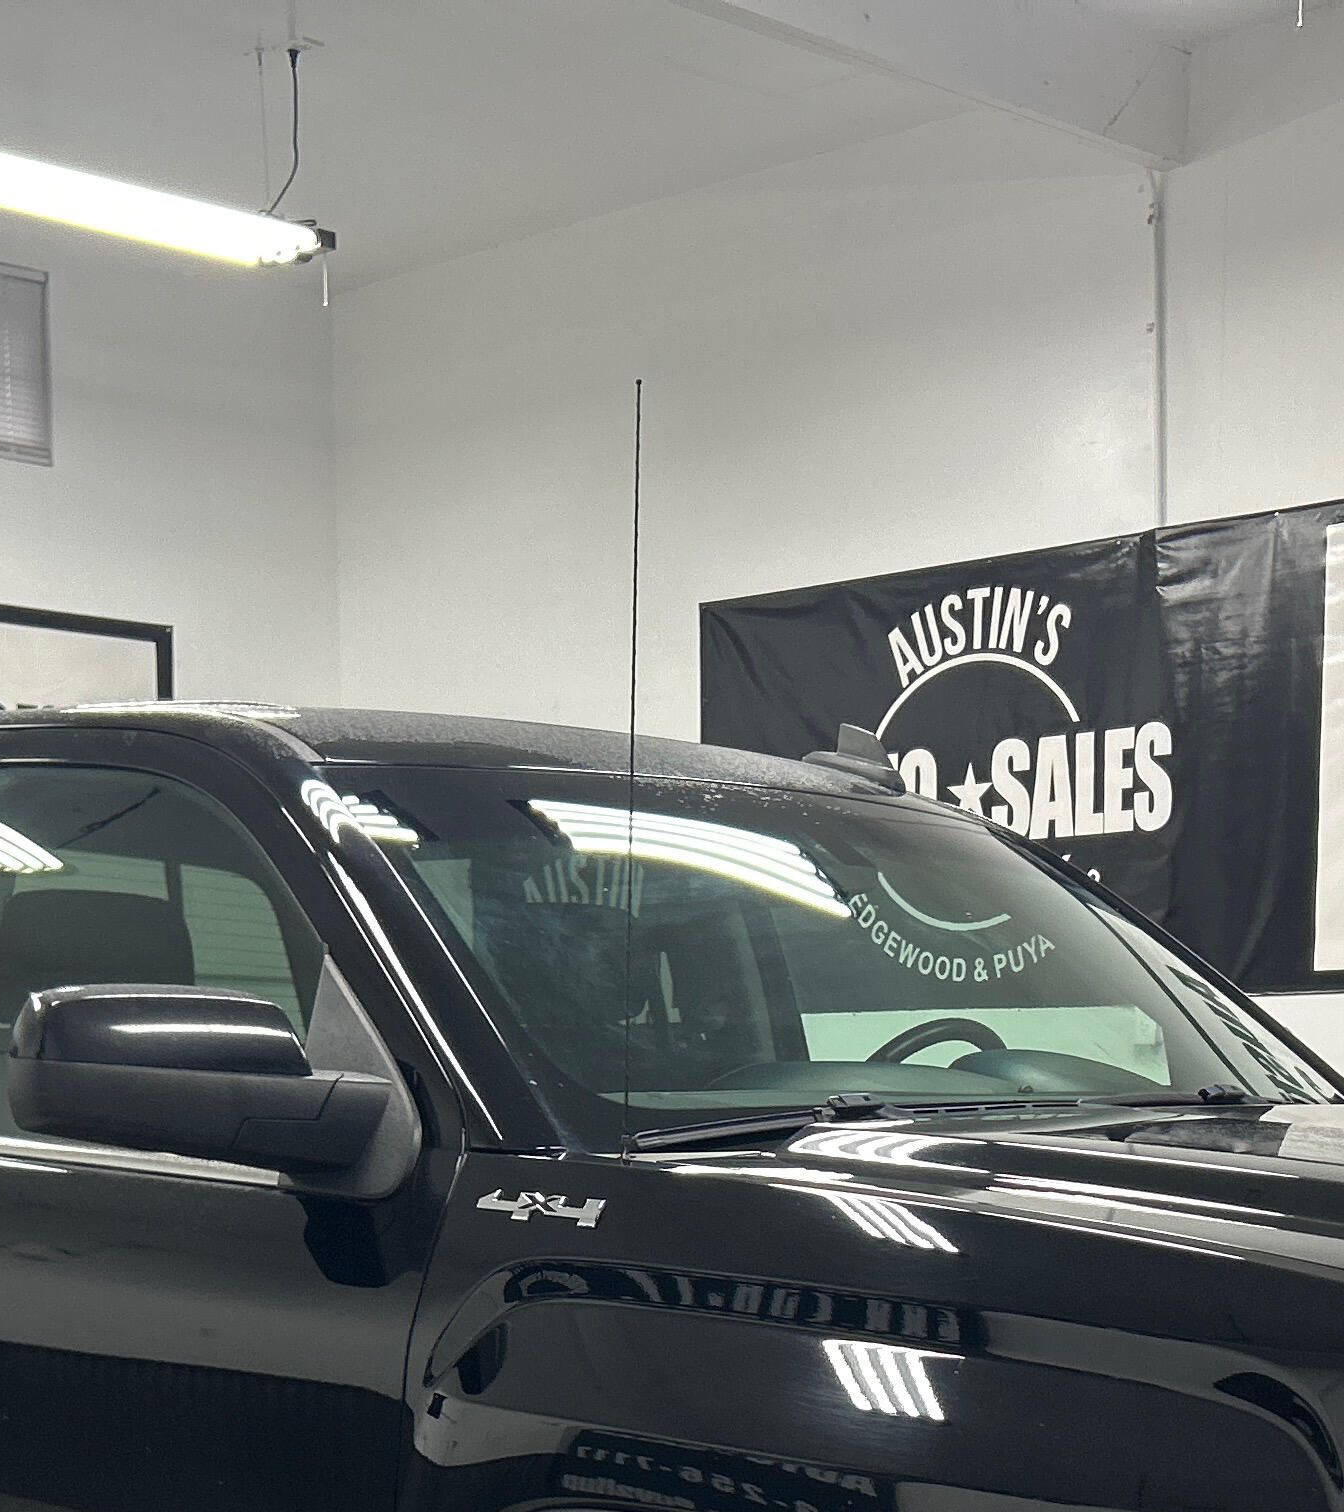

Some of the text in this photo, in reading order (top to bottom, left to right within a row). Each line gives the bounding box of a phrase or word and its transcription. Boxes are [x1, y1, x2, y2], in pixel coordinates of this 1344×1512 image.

[887, 587, 1072, 689] AUSTIN'S
[991, 721, 1173, 841] SALES
[848, 893, 967, 982] EDGEWOOD
[973, 957, 989, 982] &
